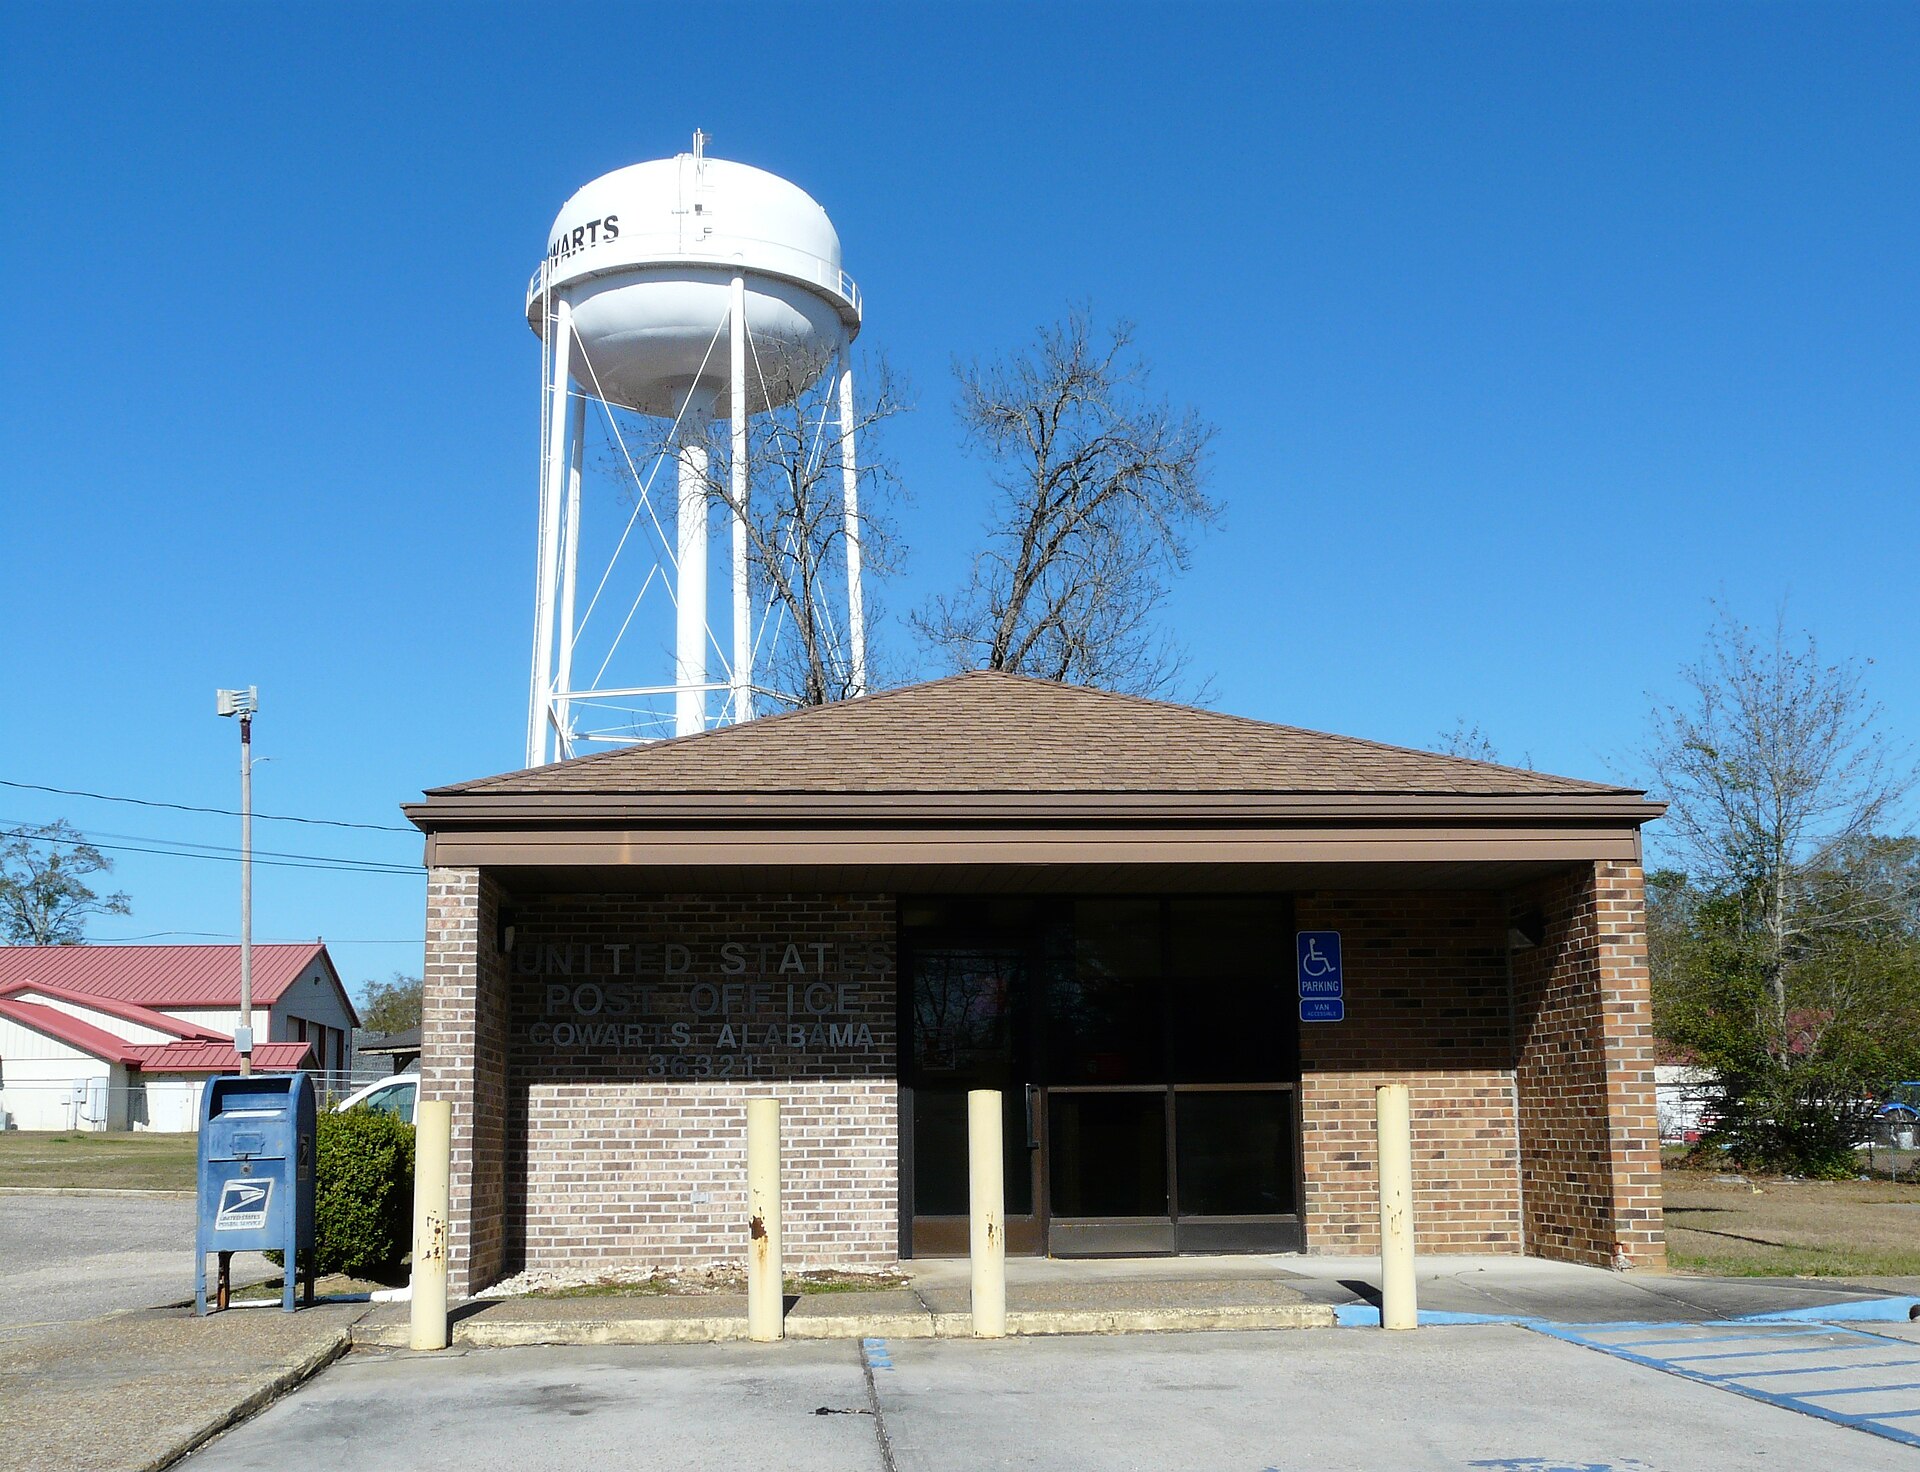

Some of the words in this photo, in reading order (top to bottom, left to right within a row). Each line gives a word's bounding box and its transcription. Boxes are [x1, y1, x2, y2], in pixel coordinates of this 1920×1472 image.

[516, 943, 692, 976] UNITED
[720, 942, 893, 975] STATES
[546, 983, 658, 1016] POST
[689, 982, 865, 1016] OFFICE
[1302, 981, 1339, 992] PARKING
[1314, 1003, 1329, 1011] VAN
[528, 1021, 692, 1048] COWARTS
[716, 1022, 875, 1048] ALABAMA
[647, 1053, 755, 1079] 36321
